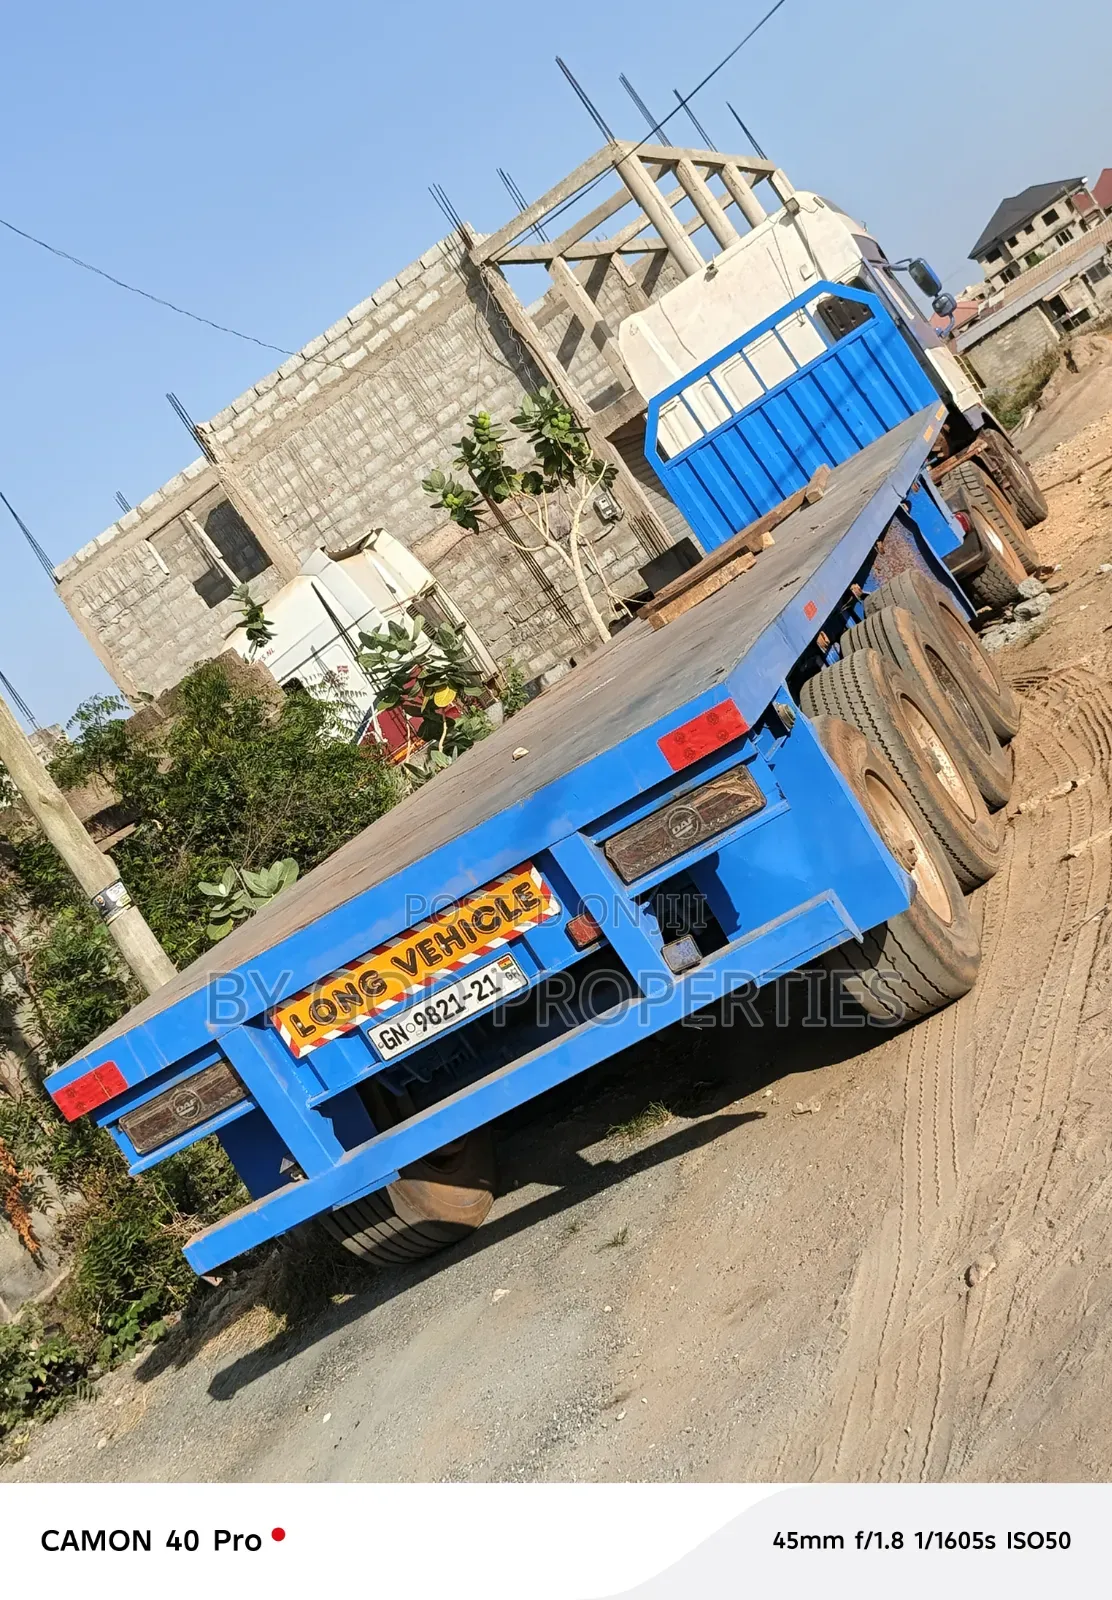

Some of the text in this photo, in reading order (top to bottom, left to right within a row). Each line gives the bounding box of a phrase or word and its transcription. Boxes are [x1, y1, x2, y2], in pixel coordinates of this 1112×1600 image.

[671, 814, 696, 835] DAF
[288, 881, 542, 1038] LONG VEHICLE
[378, 974, 501, 1051] GN 9821-21
[175, 1096, 197, 1114] DAF
